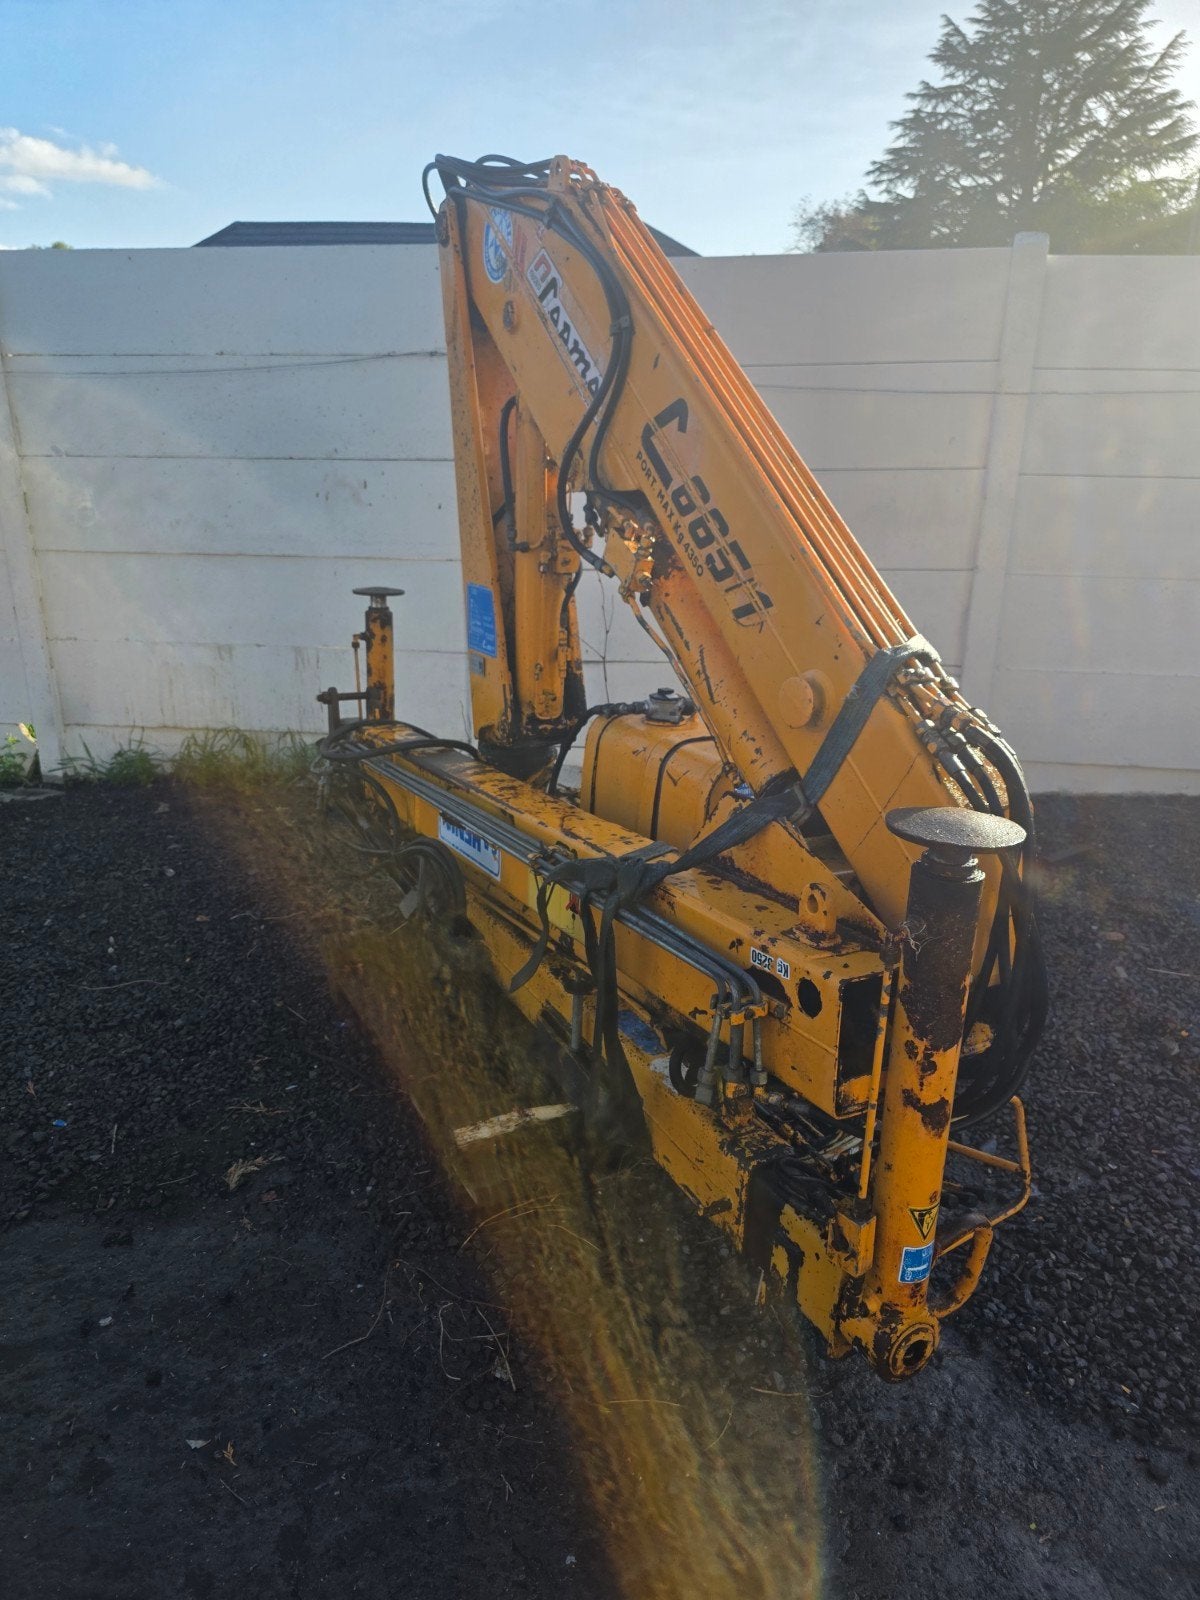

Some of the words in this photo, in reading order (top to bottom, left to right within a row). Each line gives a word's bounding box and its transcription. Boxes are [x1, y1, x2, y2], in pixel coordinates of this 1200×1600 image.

[636, 451, 656, 490] PORT.
[656, 490, 675, 522] MAX
[673, 520, 684, 544] Kg
[684, 542, 704, 577] 4350
